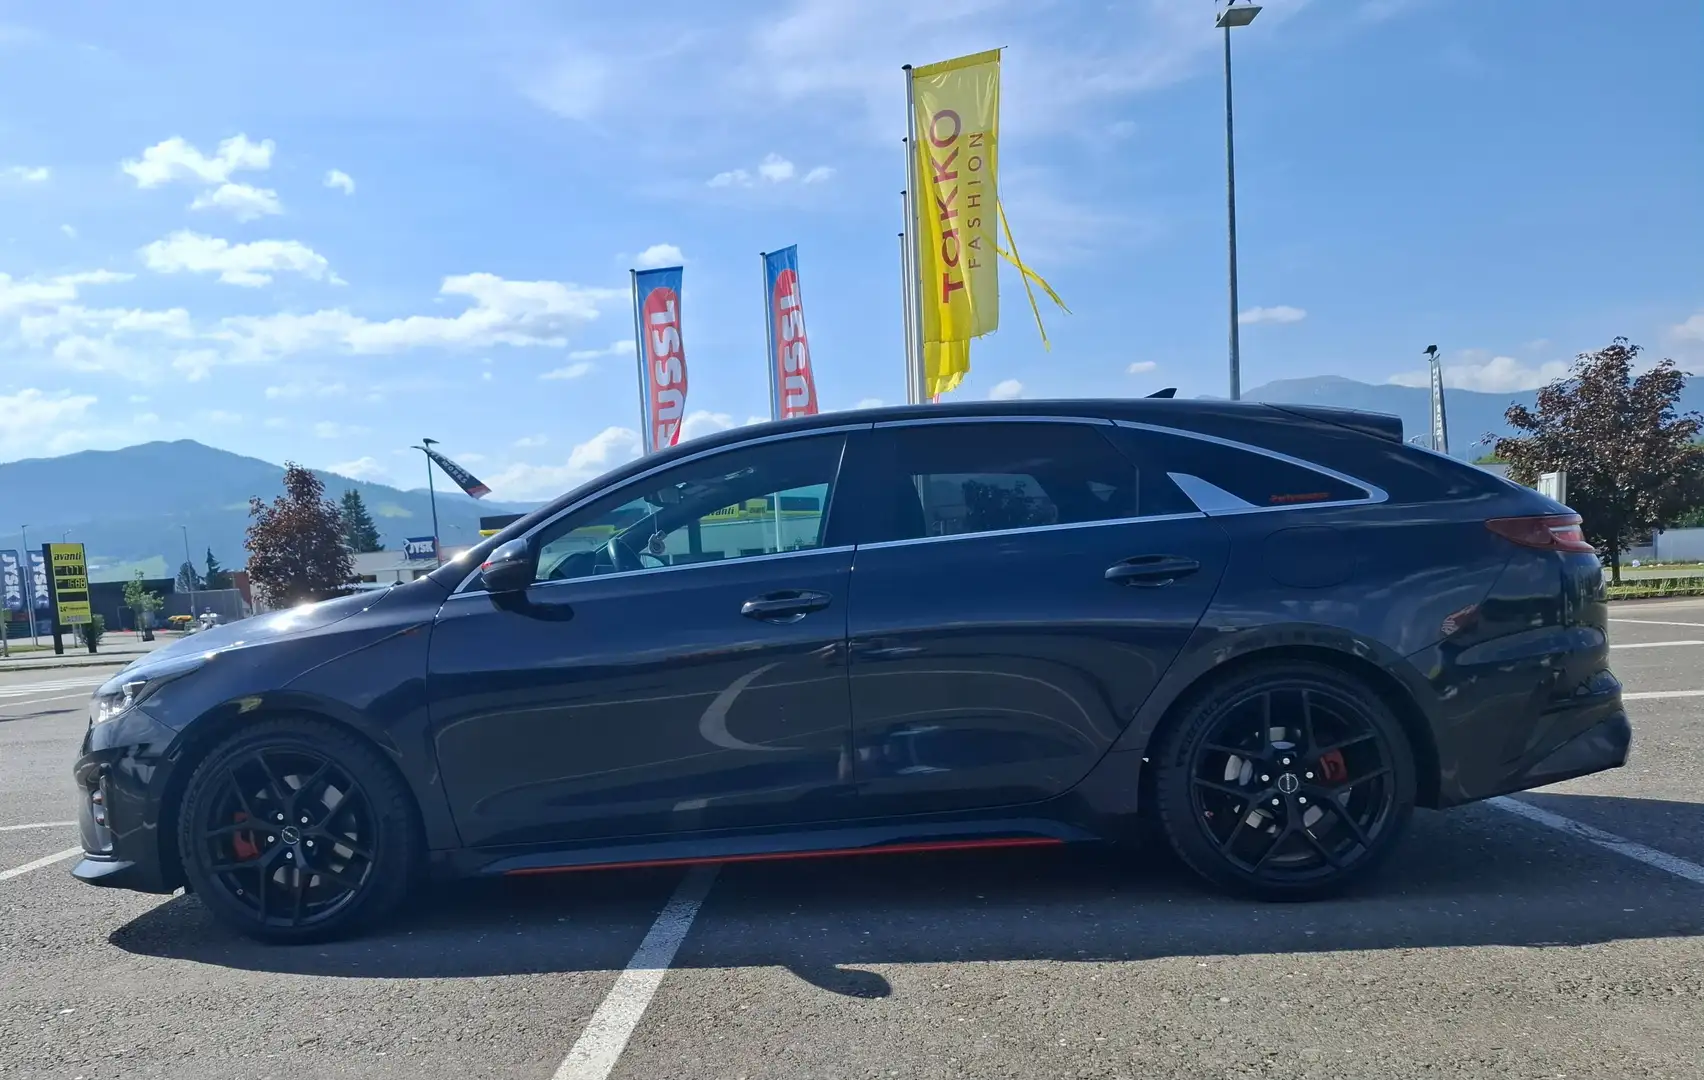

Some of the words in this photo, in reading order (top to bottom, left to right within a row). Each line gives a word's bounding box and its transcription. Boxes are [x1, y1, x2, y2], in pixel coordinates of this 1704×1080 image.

[968, 131, 984, 269] FASHION
[54, 552, 82, 561] avanti
[408, 540, 434, 554] JYSK
[2, 553, 21, 599] JYSK
[31, 553, 49, 598] JYSK
